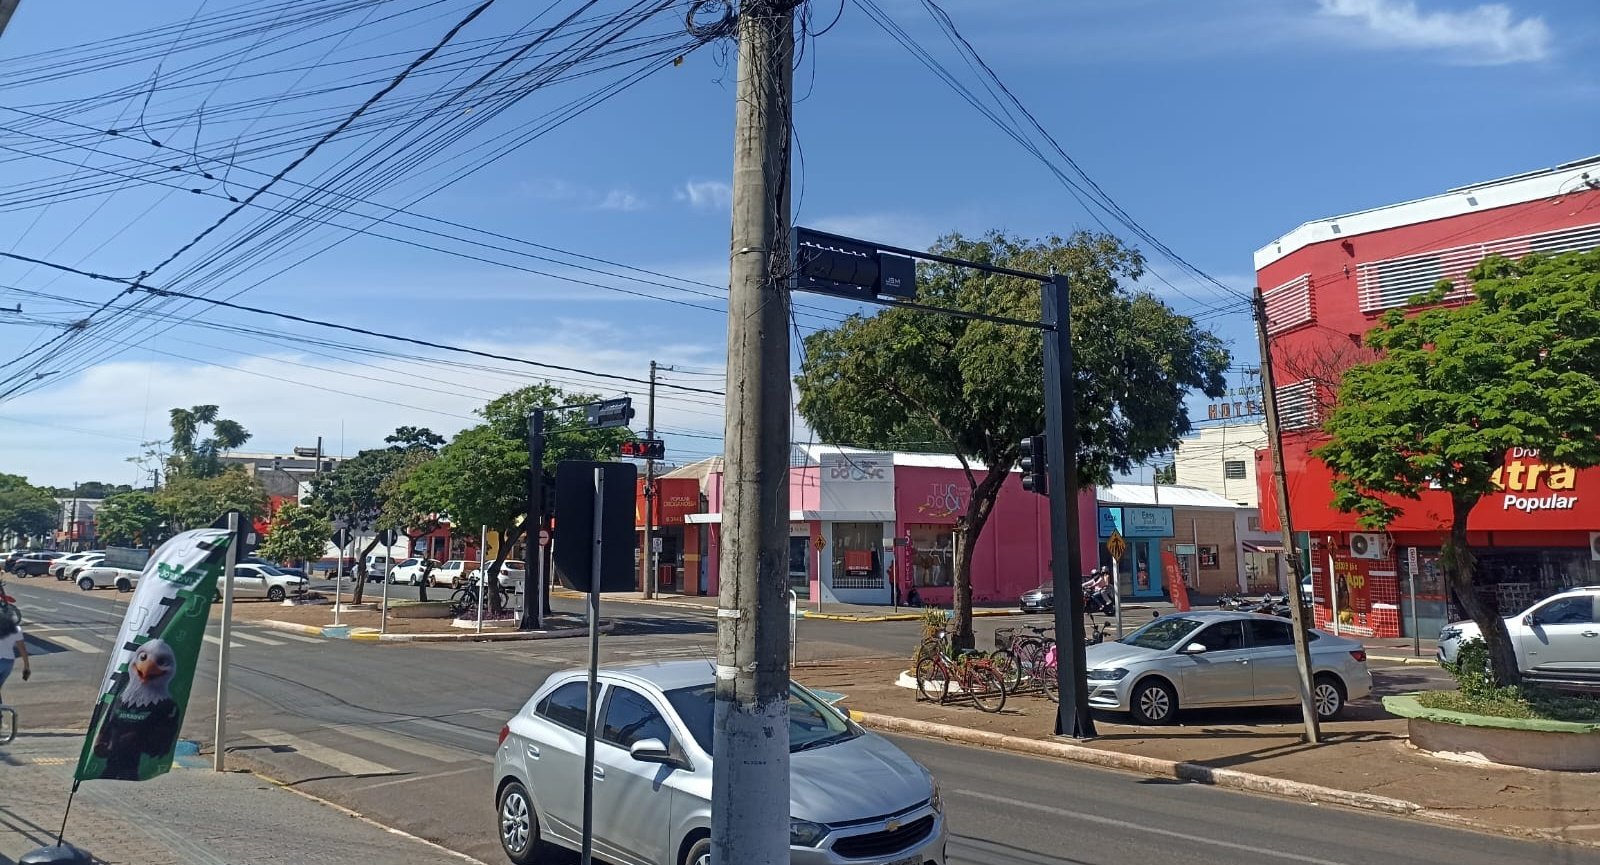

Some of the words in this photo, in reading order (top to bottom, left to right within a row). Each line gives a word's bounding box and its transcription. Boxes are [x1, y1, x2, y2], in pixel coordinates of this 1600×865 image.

[930, 482, 947, 496] TU
[927, 495, 944, 508] DO
[1503, 492, 1577, 513] Popular
[1346, 571, 1365, 589] App
